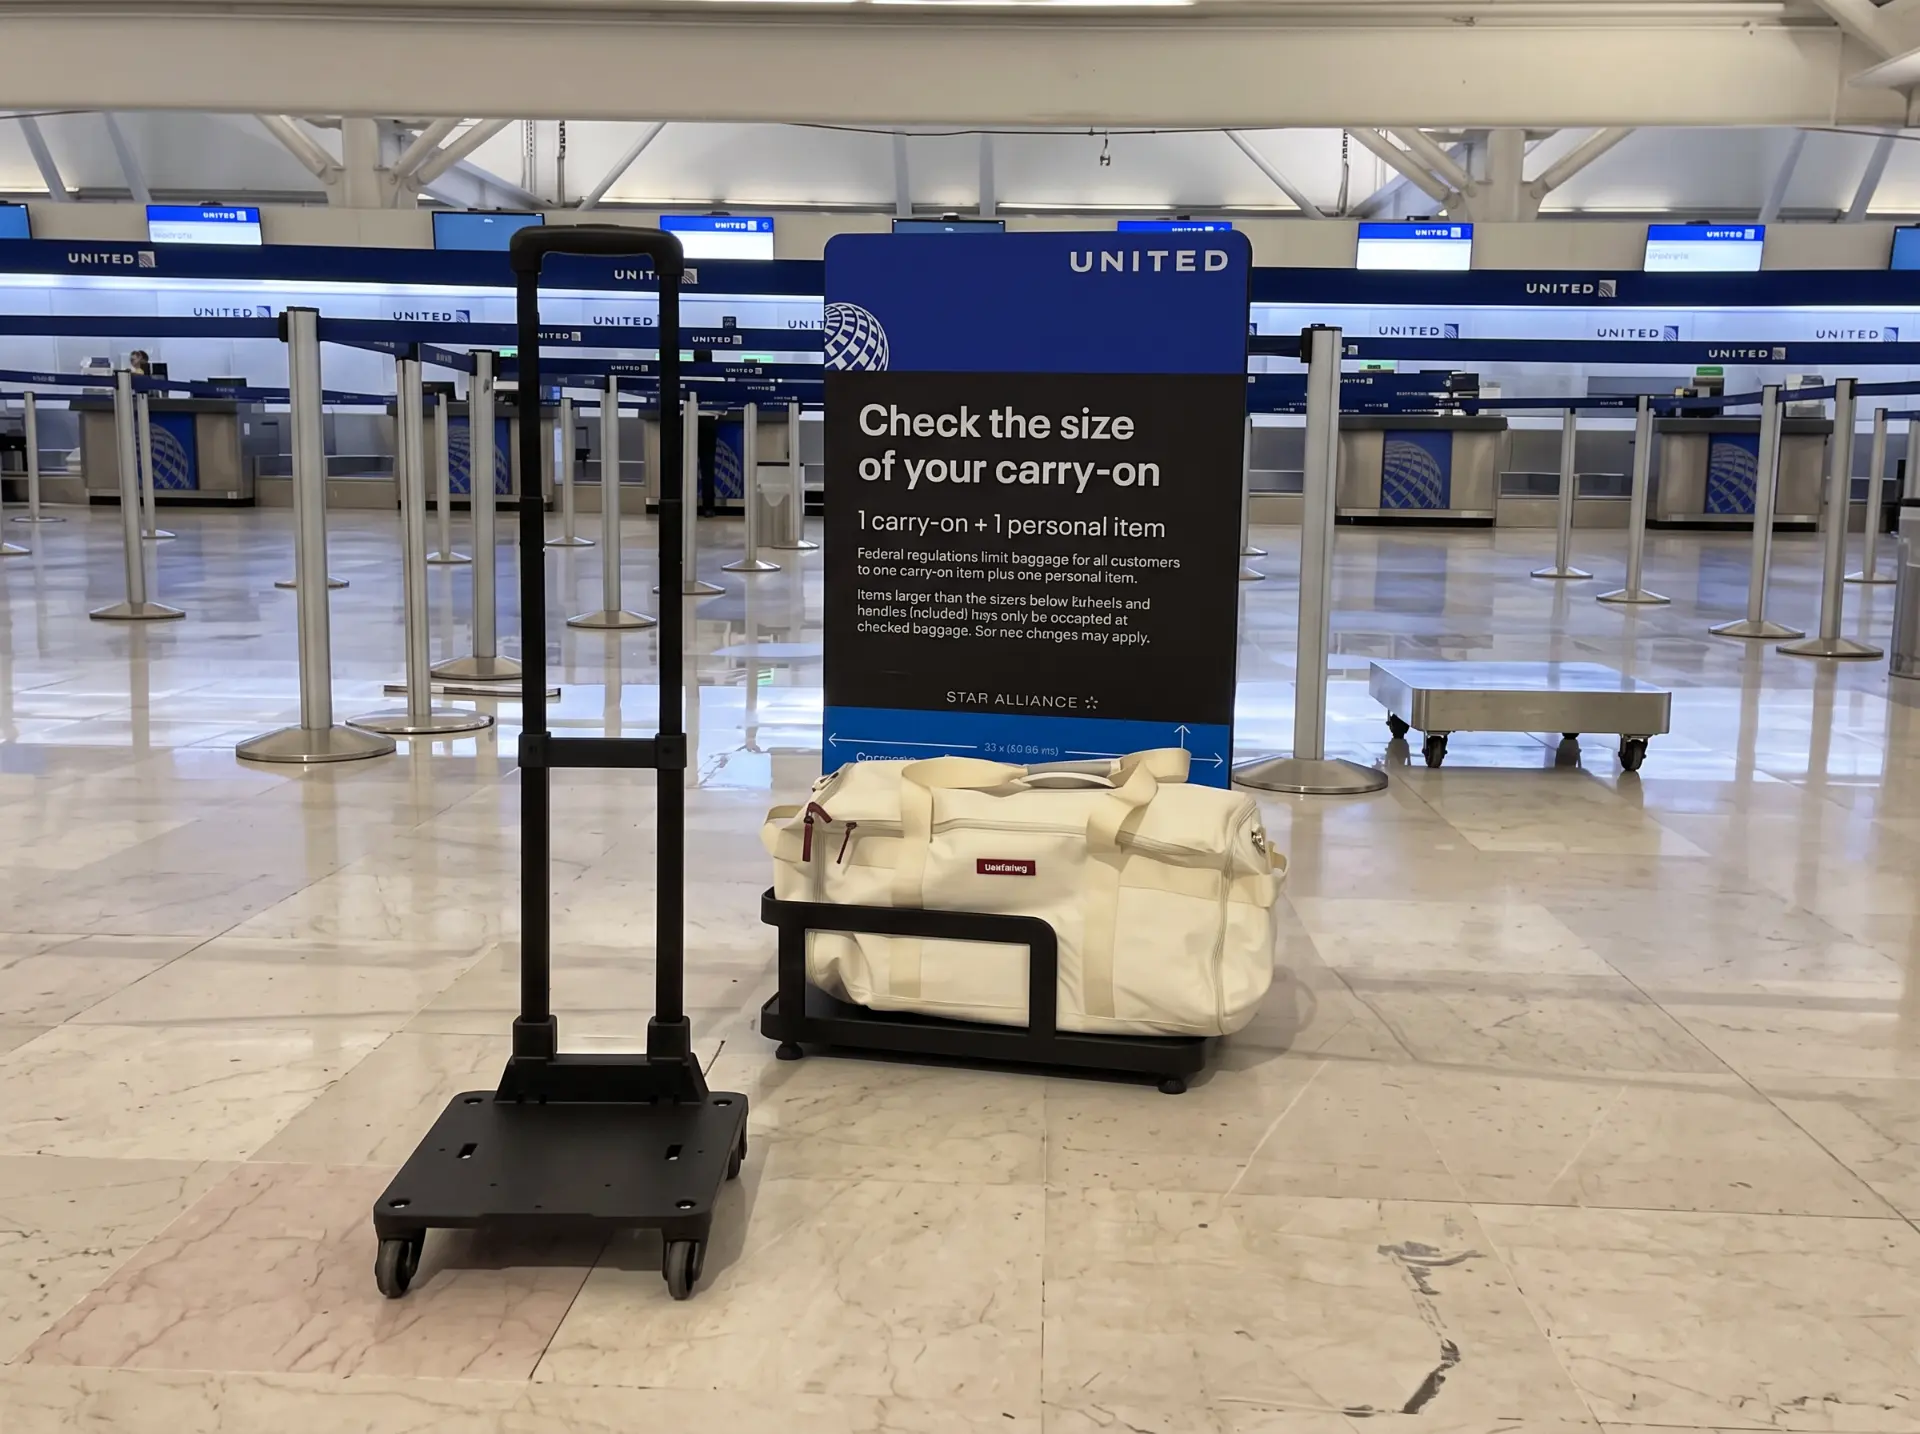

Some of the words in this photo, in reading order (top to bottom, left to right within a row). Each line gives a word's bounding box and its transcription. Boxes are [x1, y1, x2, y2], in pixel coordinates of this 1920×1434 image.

[1707, 230, 1742, 238] UNITED
[68, 253, 134, 264] UNITED
[1070, 250, 1229, 272] UNITED
[614, 270, 655, 280] UNIT
[1526, 283, 1594, 294] UNITED
[193, 308, 252, 318] UNITED
[393, 312, 452, 321] UNITED
[593, 316, 653, 326] UNITED
[787, 320, 824, 329] UNIT
[1378, 326, 1440, 336] UNITED
[1597, 329, 1659, 338] UNITED
[1816, 330, 1879, 339] UNITED
[1708, 349, 1768, 358] UNITED
[859, 404, 981, 437] Check
[989, 406, 1050, 439] the
[1060, 407, 1135, 440] size
[859, 450, 895, 481] of
[904, 459, 987, 489] your
[995, 459, 1160, 493] carry-on
[857, 510, 865, 530] 1
[872, 514, 968, 536] carry-on
[994, 514, 1001, 533] 1
[1008, 516, 1107, 538] personal
[1114, 517, 1165, 537] item
[857, 548, 904, 560] Federal
[907, 550, 978, 563] regulations
[981, 551, 1008, 564] limit
[1011, 552, 1069, 567] baggage
[1072, 554, 1090, 566] for
[1093, 554, 1108, 566] all
[1110, 556, 1181, 568] customers
[857, 565, 869, 576] to
[873, 567, 897, 576] one
[900, 567, 953, 580] carry-on
[956, 567, 984, 580] item
[988, 568, 1014, 583] plus
[1017, 571, 1042, 581] one
[1045, 571, 1101, 584] personal
[1105, 571, 1137, 584] item.
[857, 589, 892, 601] Items
[895, 590, 931, 604] larger
[934, 591, 962, 603] than
[966, 592, 987, 604] the
[989, 593, 1026, 605] sizers
[1030, 594, 1068, 607] below
[1126, 598, 1150, 610] and
[1001, 610, 1028, 624] only
[1031, 610, 1047, 623] be
[1050, 612, 1111, 627] occapted
[1115, 615, 1128, 626] at
[857, 621, 909, 634] checked
[913, 622, 971, 639] baggage.
[975, 625, 997, 637] Sor
[1000, 628, 1023, 638] nec
[1082, 632, 1108, 643] may
[1112, 631, 1150, 646] apply.
[946, 691, 988, 704] STAR
[995, 693, 1077, 708] ALLIANCE
